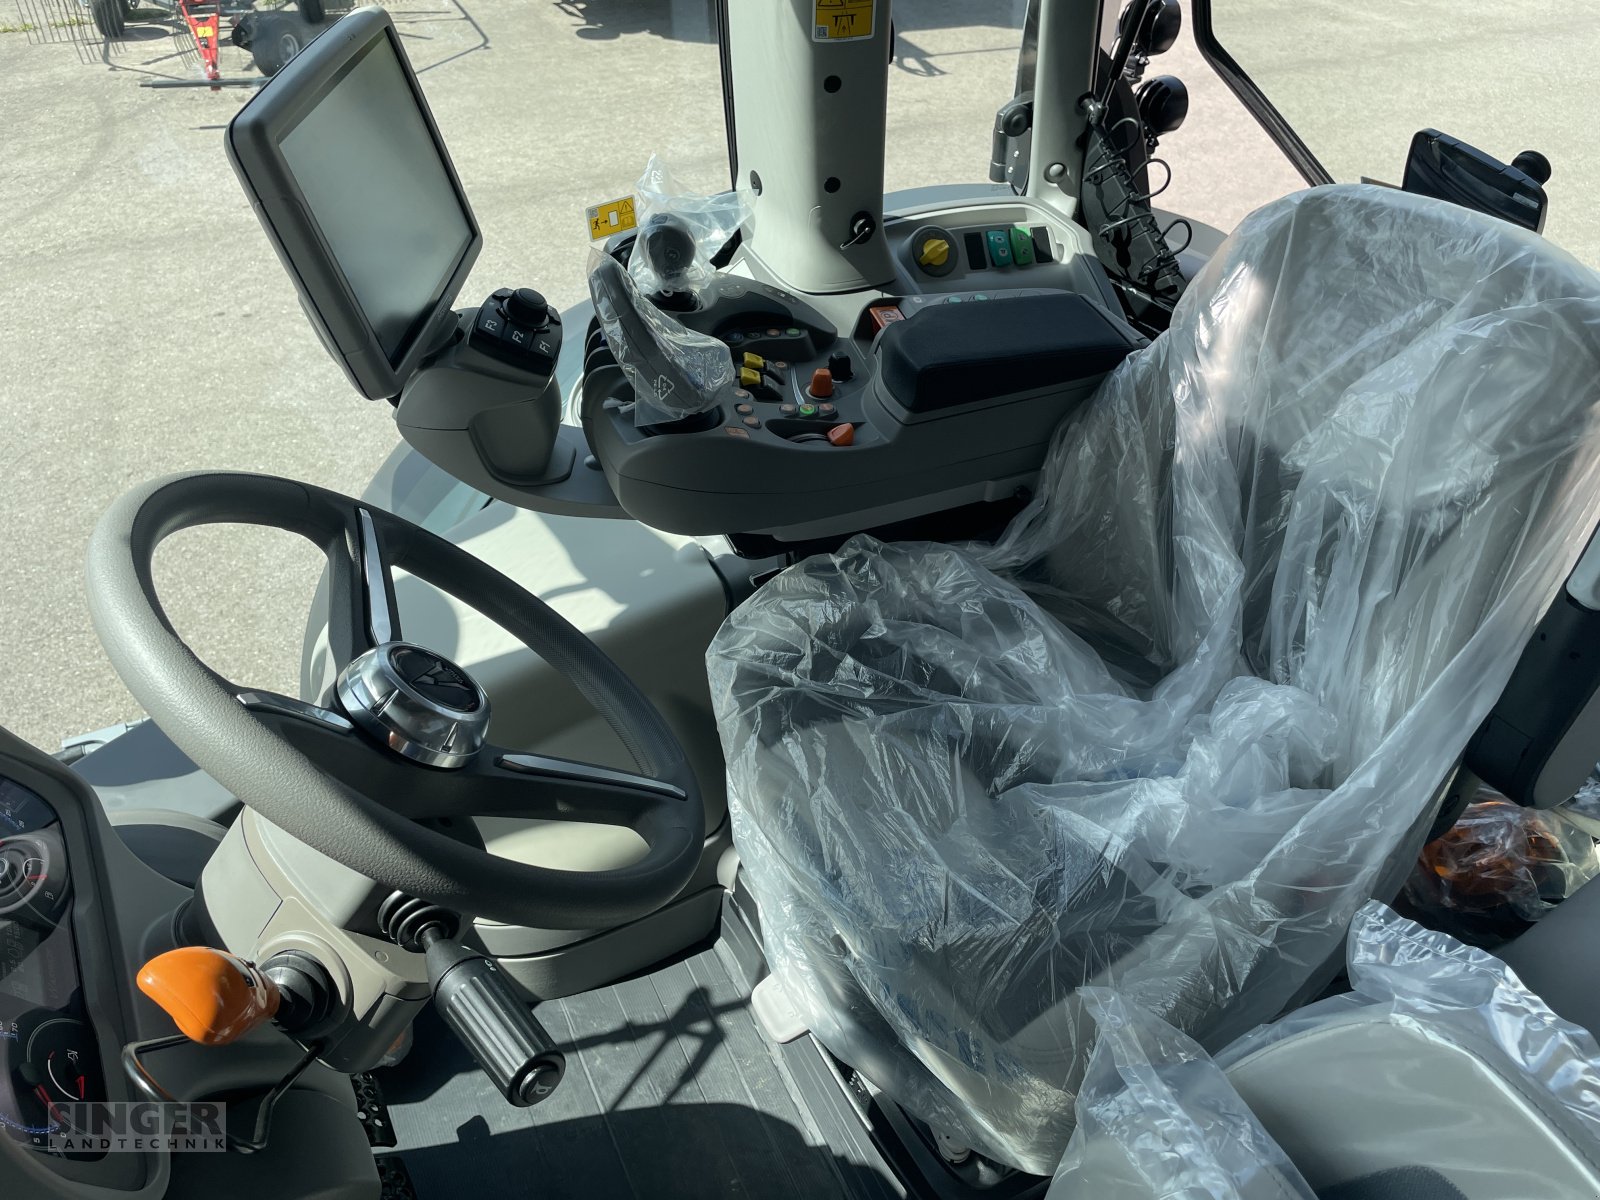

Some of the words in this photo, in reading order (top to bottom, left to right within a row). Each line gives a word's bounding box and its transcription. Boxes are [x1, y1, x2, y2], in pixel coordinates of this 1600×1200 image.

[485, 319, 498, 331] F3
[512, 330, 524, 344] F2
[539, 341, 551, 354] F1
[11, 1022, 18, 1032] 70
